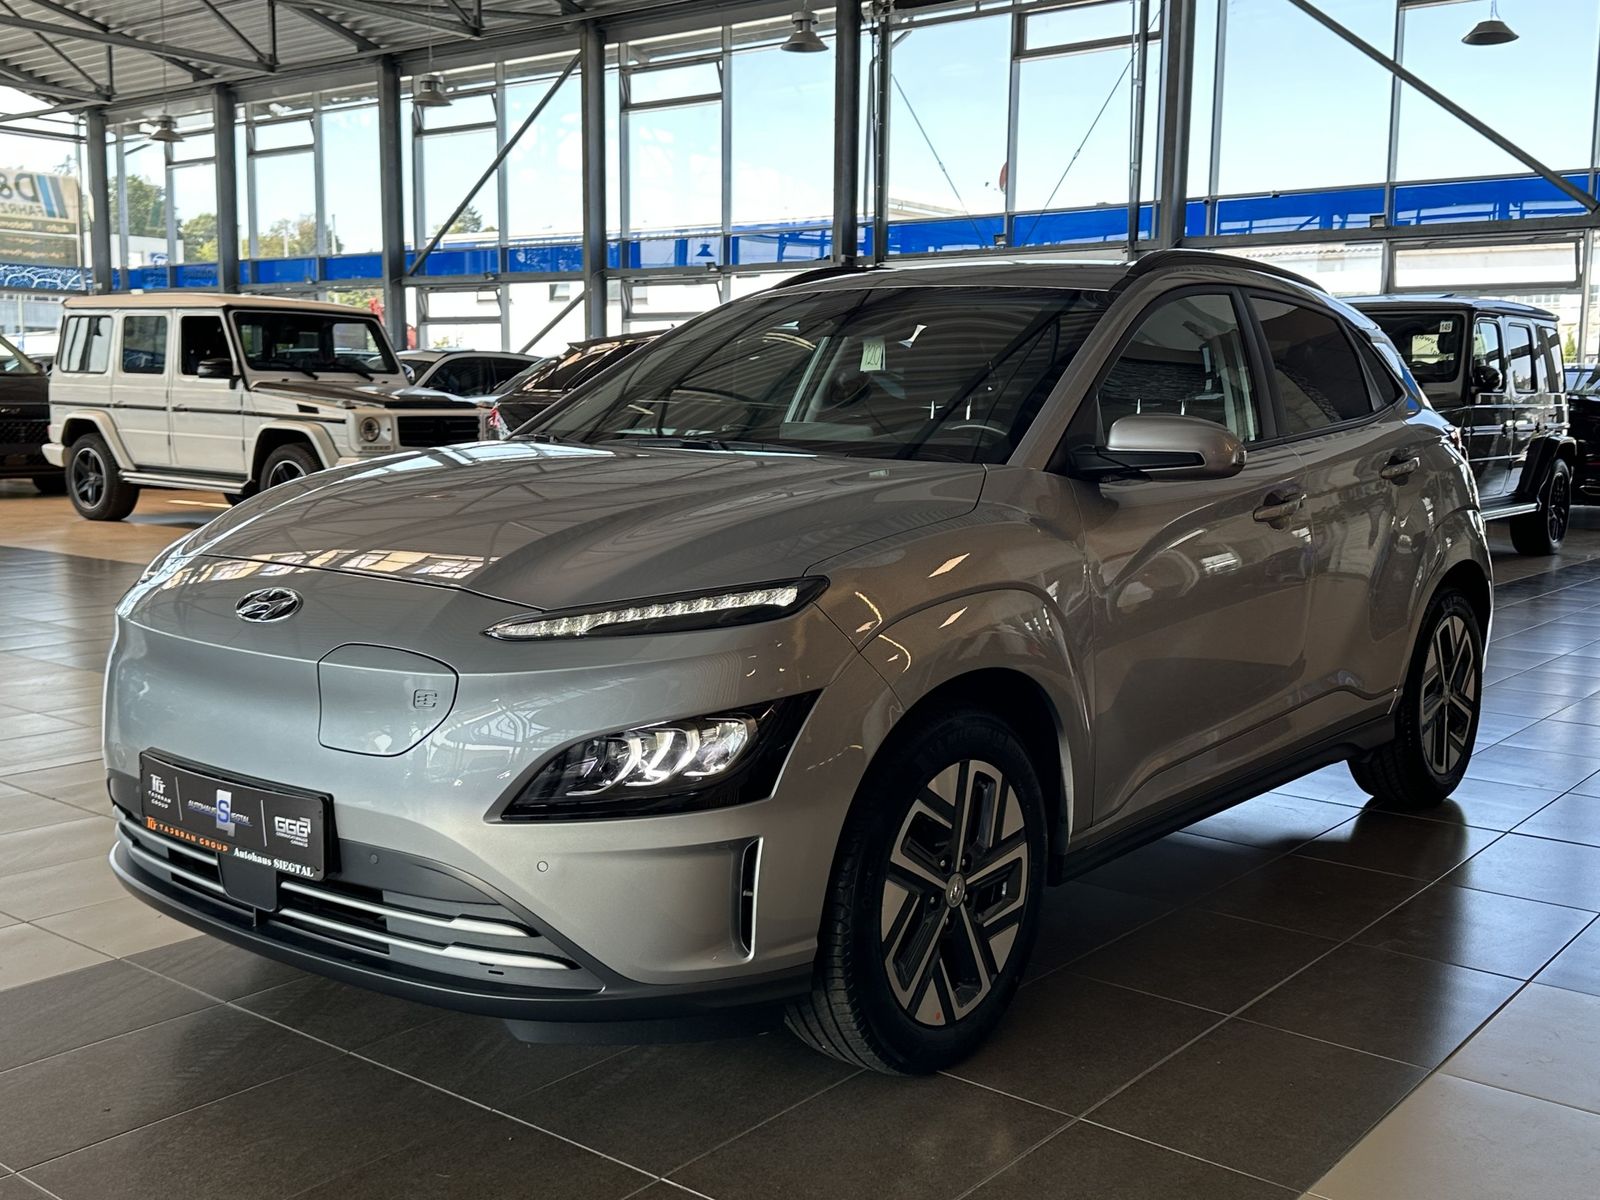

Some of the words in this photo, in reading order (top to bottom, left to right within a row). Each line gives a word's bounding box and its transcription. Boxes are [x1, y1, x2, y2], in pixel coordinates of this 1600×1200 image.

[199, 837, 229, 852] GROUP
[233, 847, 272, 866] Autohaus
[273, 858, 314, 877] SIEGTAL
